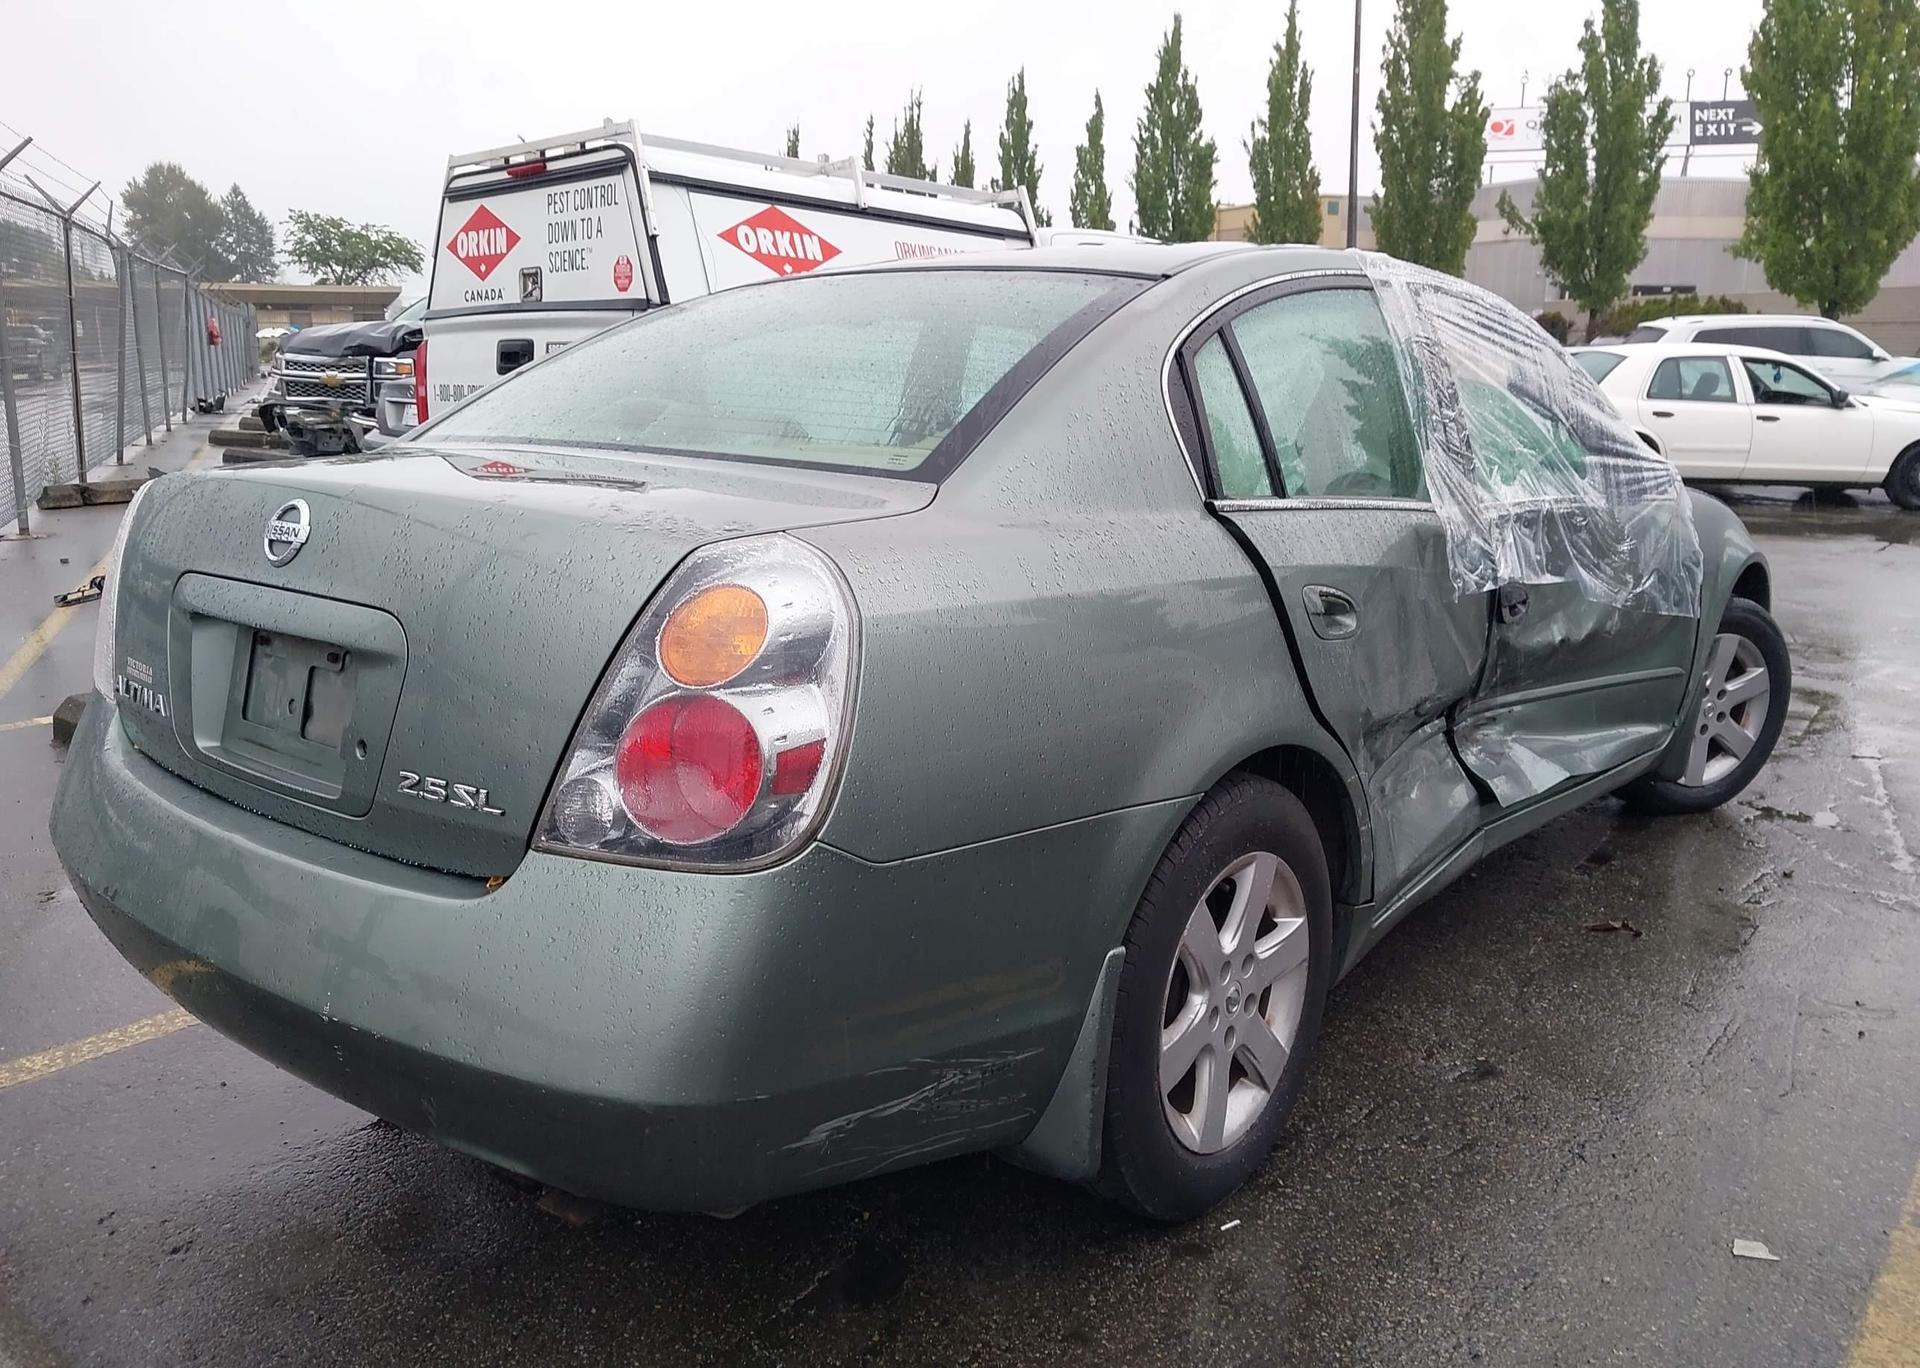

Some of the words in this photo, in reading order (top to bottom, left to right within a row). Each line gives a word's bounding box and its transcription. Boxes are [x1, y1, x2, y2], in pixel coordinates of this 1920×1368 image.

[1695, 108, 1736, 122] NEXT
[1695, 123, 1737, 137] EXIT
[547, 190, 570, 215] PEST
[573, 183, 619, 212] CONTROL
[456, 226, 508, 259] ORKIN
[547, 219, 577, 244] DOWN
[580, 217, 593, 240] TO
[595, 215, 603, 239] A
[736, 224, 824, 262] ORKIN
[464, 288, 504, 303] CANADA
[115, 674, 169, 717] ALTIMA
[450, 783, 506, 816] SL
